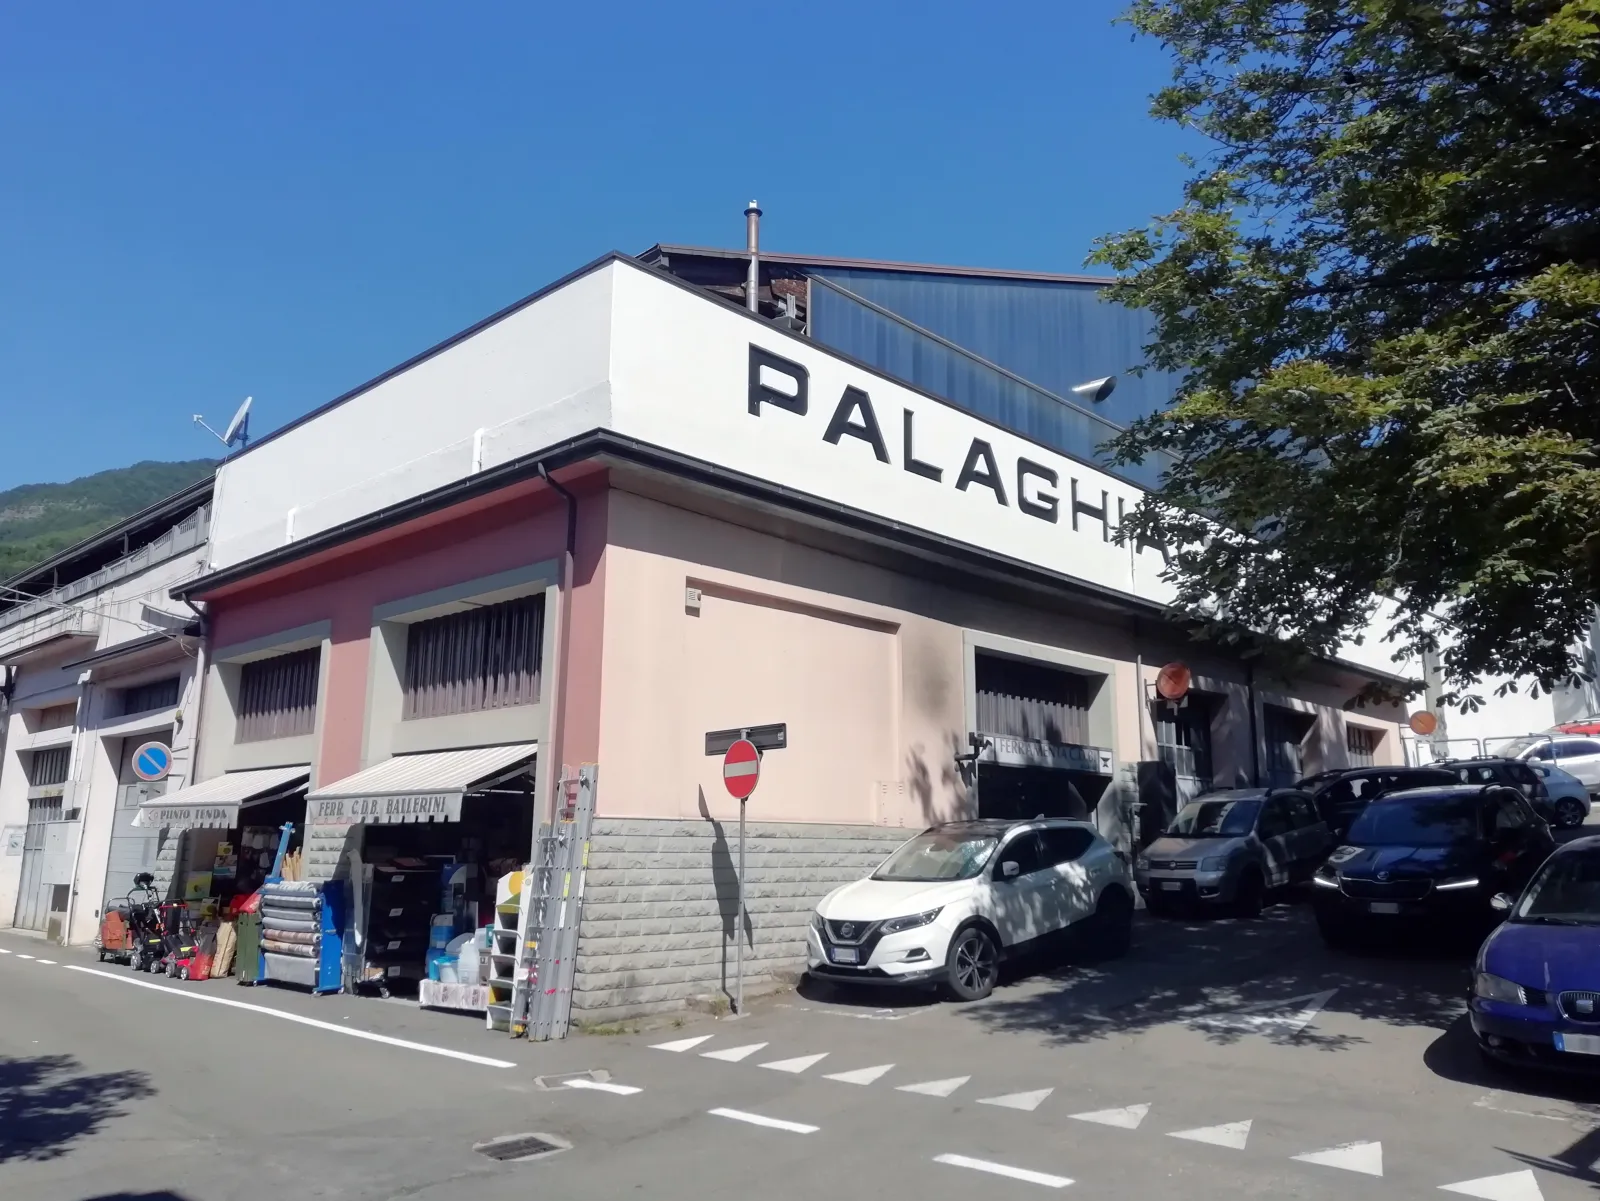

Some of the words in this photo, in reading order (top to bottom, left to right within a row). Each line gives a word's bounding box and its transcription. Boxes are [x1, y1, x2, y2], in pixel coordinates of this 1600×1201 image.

[160, 808, 191, 820] PUNTO
[195, 808, 227, 819] TENDA
[318, 801, 344, 816] FERR.
[351, 799, 379, 815] C.D.B.
[386, 796, 446, 814] BALLERINI
